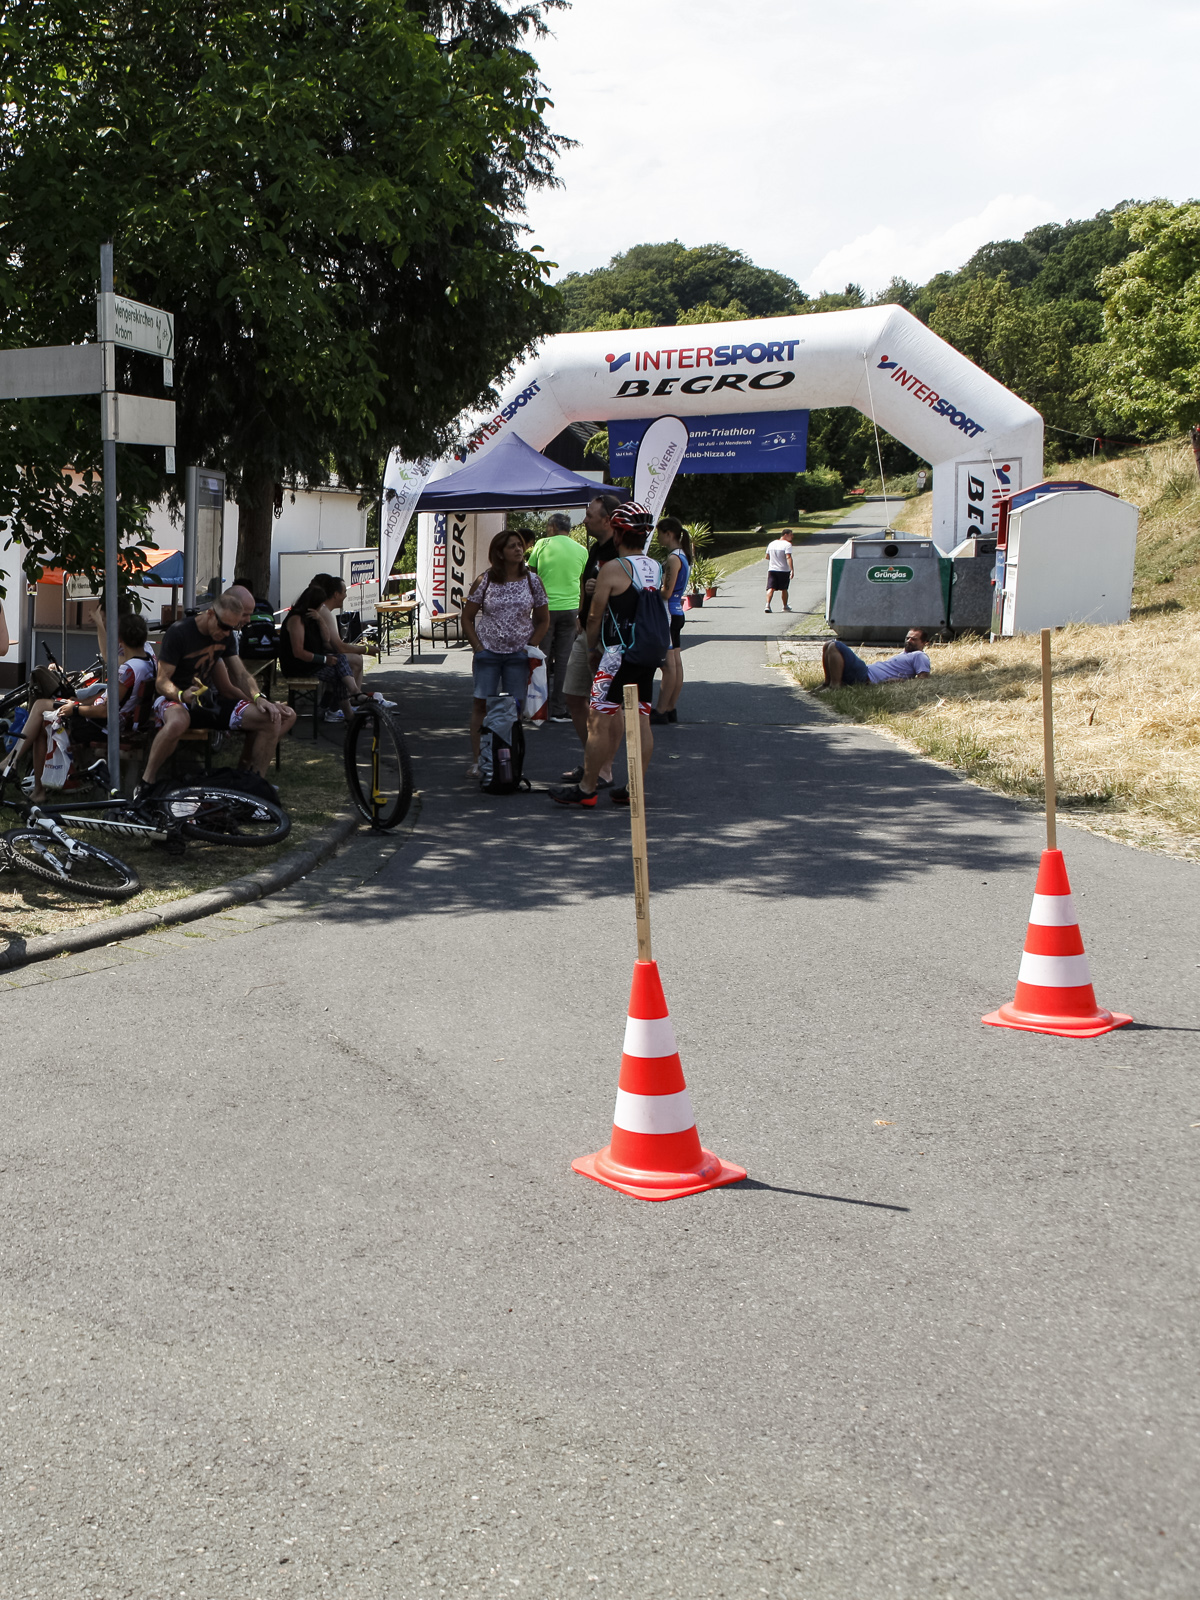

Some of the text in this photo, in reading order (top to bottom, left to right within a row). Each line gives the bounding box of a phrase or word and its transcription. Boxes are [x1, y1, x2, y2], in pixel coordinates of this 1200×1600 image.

[114, 323, 133, 341] Arborn
[635, 340, 800, 372] INTERSPORT
[610, 370, 796, 399] BEGRO
[890, 366, 986, 439] INTERSPORT
[689, 427, 756, 438] ann-Triathlon
[643, 477, 660, 511] SPORT
[657, 441, 678, 471] WERN
[383, 483, 412, 538] RADSPORT
[432, 513, 446, 597] INTERSPO
[874, 571, 907, 579] Grünglas
